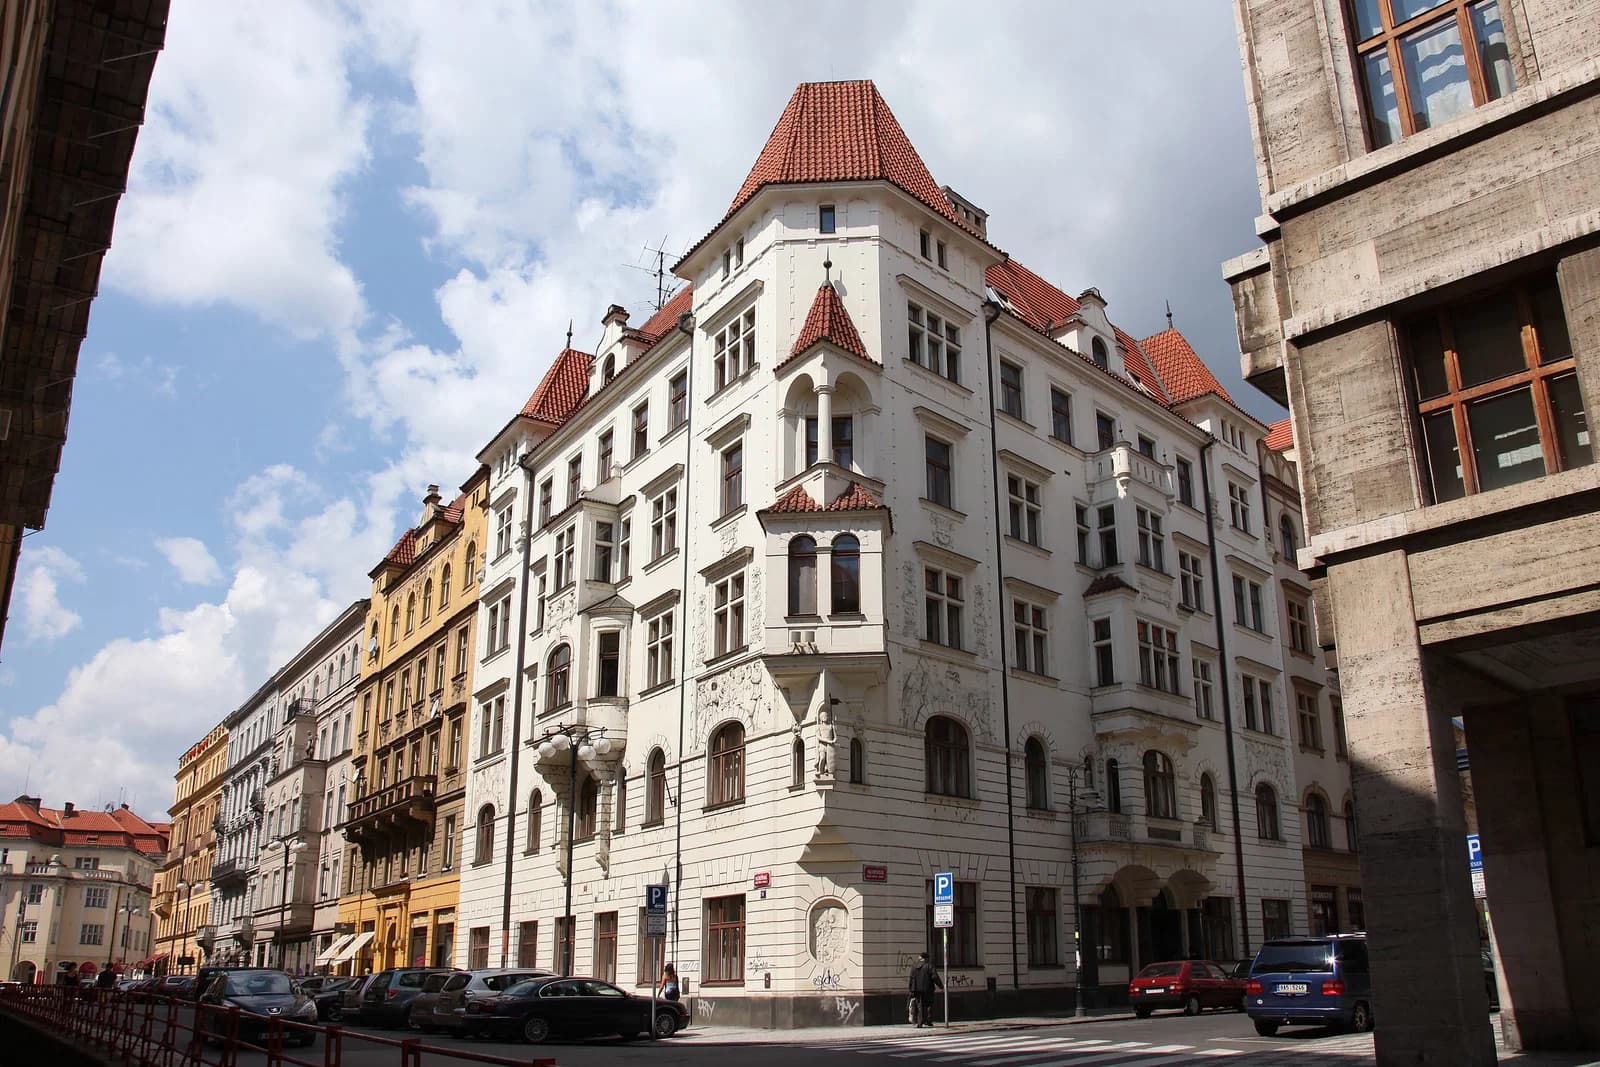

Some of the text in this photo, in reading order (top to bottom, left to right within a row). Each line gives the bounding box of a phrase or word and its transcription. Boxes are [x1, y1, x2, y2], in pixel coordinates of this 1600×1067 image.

[1468, 839, 1480, 860] P
[938, 876, 949, 895] P
[652, 887, 661, 904] P
